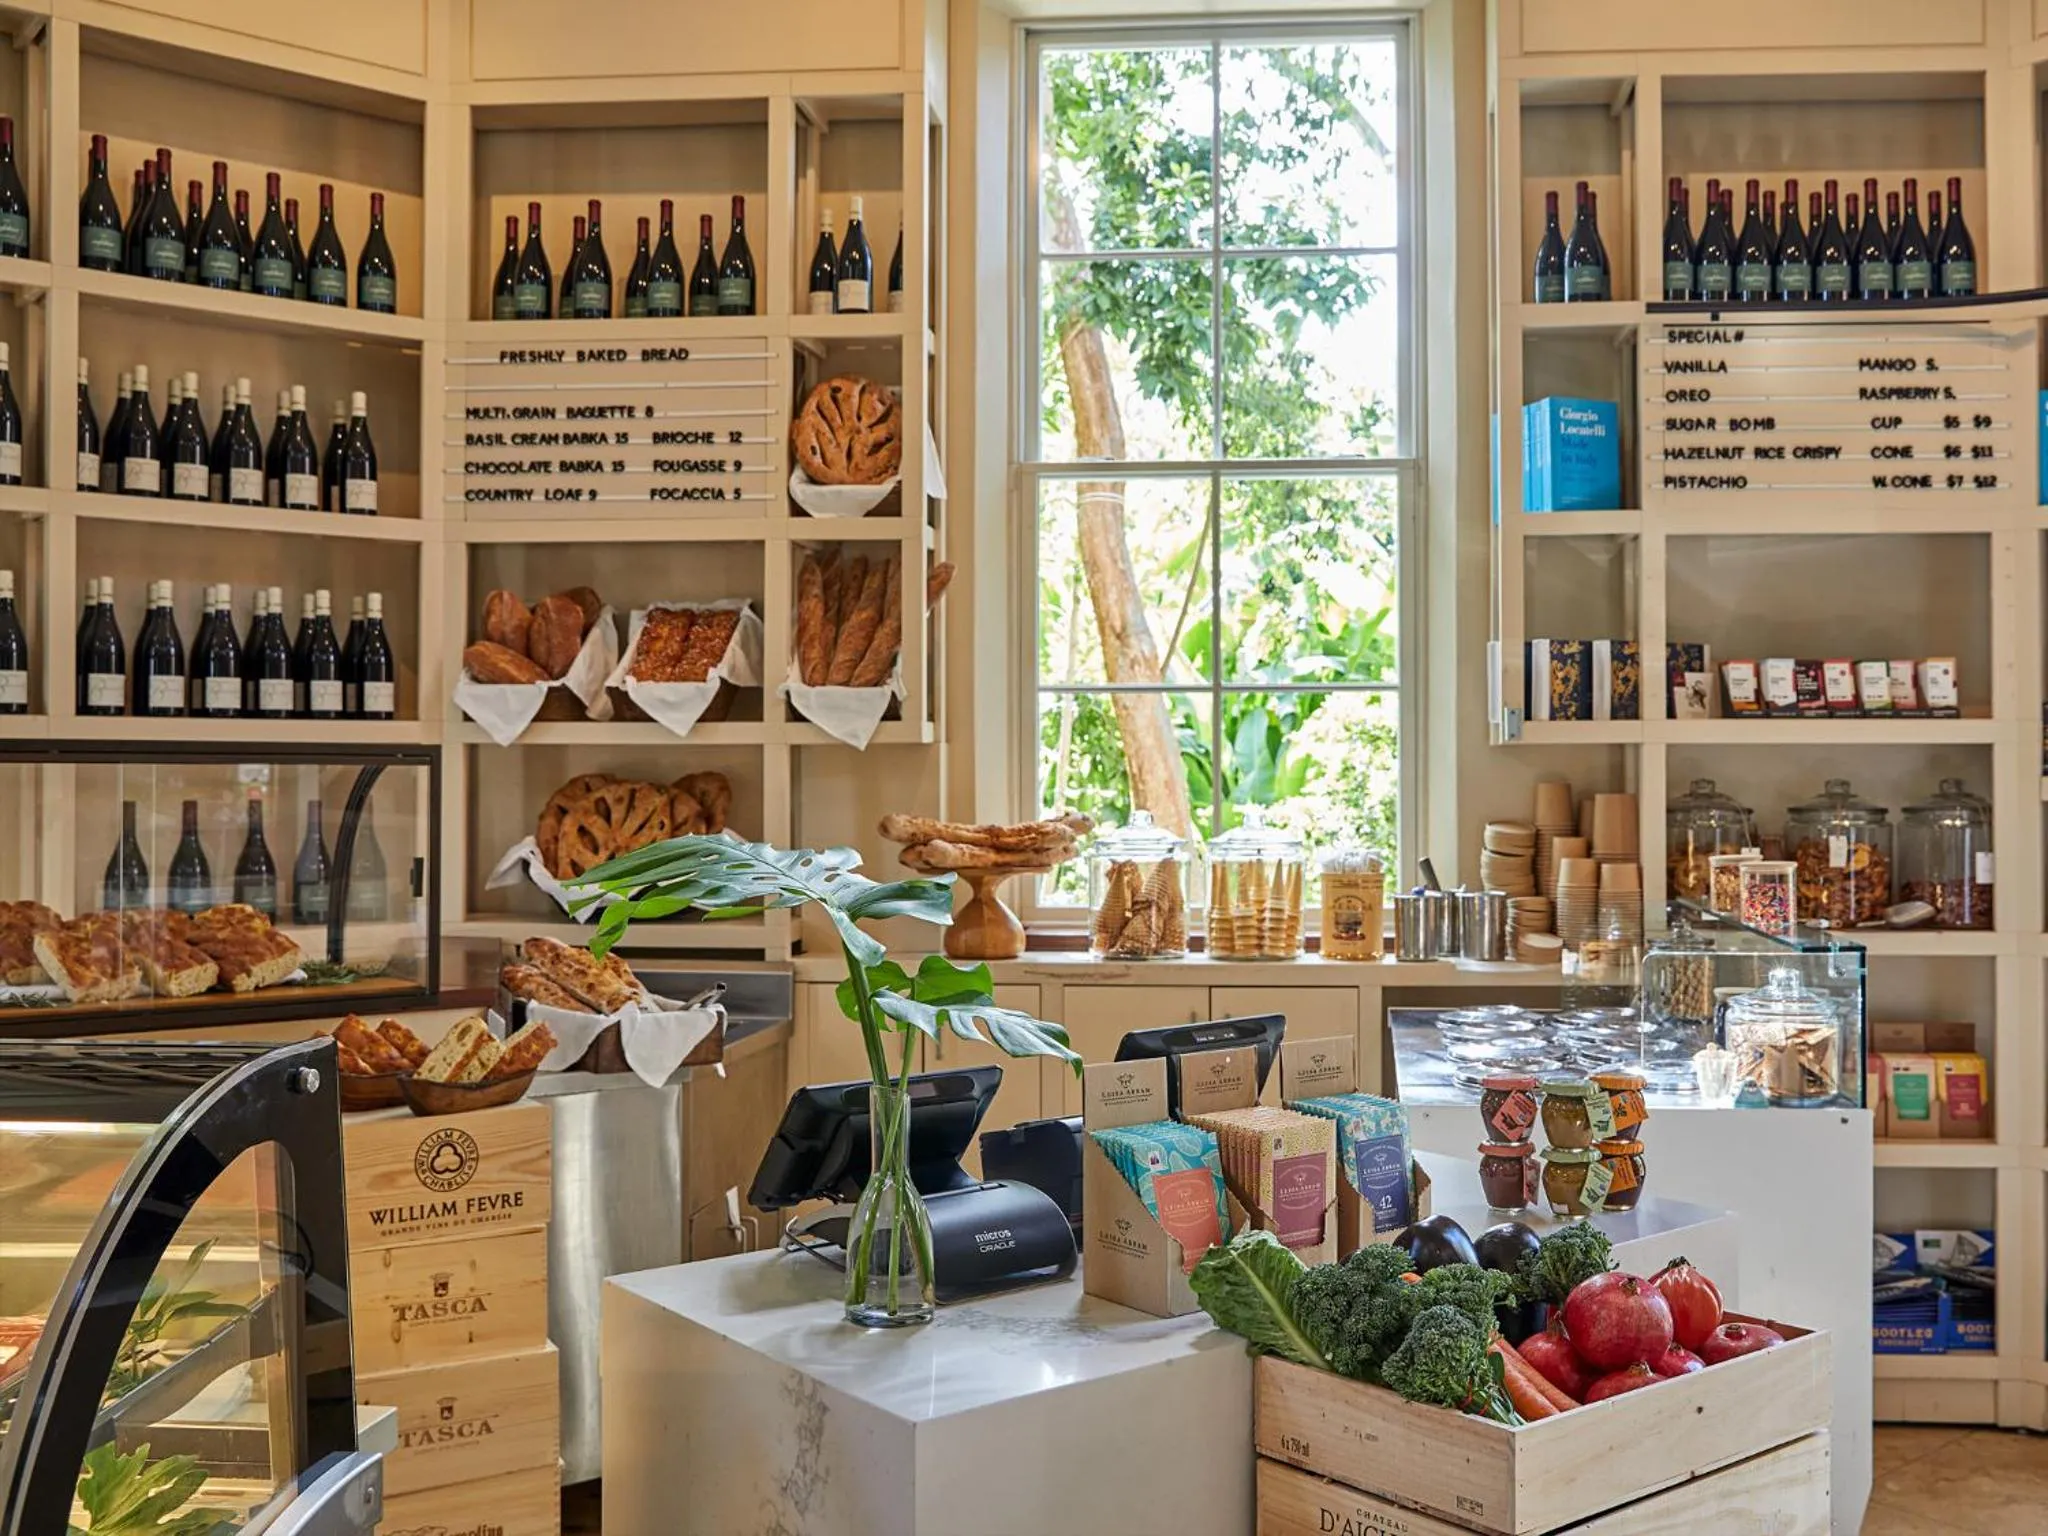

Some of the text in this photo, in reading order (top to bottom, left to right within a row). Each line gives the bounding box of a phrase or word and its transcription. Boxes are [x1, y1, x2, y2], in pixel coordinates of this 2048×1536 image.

[500, 348, 689, 363] FRESHLY BAKED BREAD
[1664, 360, 1728, 374] VANILLA
[1858, 357, 1939, 372] MANGO S.
[1665, 389, 1711, 403] OREO
[1858, 386, 1957, 400] RASPBERRY S.
[566, 405, 635, 419] BAGUETTE
[645, 405, 654, 418] 8
[1560, 422, 1606, 437] Locatelli
[1665, 417, 1776, 431] SUGAR BOMB
[1870, 414, 1992, 430] CUP $5 $9
[465, 431, 628, 446] BASIL CREAM BABKA 15
[652, 430, 742, 445] BRIOCHE 12
[1664, 446, 1842, 460] HAZELNUT RICE CRISPY
[1870, 444, 1993, 459] CONE $6 $11
[464, 460, 625, 475] CHOCOLATE BABKA 15
[653, 459, 742, 473] FOUGASSE 9
[1664, 476, 1748, 490] PISTACHIO
[1891, 475, 1933, 489] CONE
[1946, 474, 1964, 489] $7
[1973, 474, 1997, 489] $12
[464, 488, 597, 502] COUNTRY LOAF 9
[650, 487, 741, 501] FOCACCIA 5
[417, 1131, 477, 1169] WILLIAM FEVRE
[423, 1171, 470, 1189] CHABLIS
[369, 1191, 524, 1226] WILLIAM FEVRE
[1380, 1195, 1393, 1209] 42
[975, 1229, 1012, 1243] micros
[979, 1240, 1016, 1253] ORACLE
[390, 1297, 488, 1322] TASCA
[398, 1420, 495, 1448] TASCA
